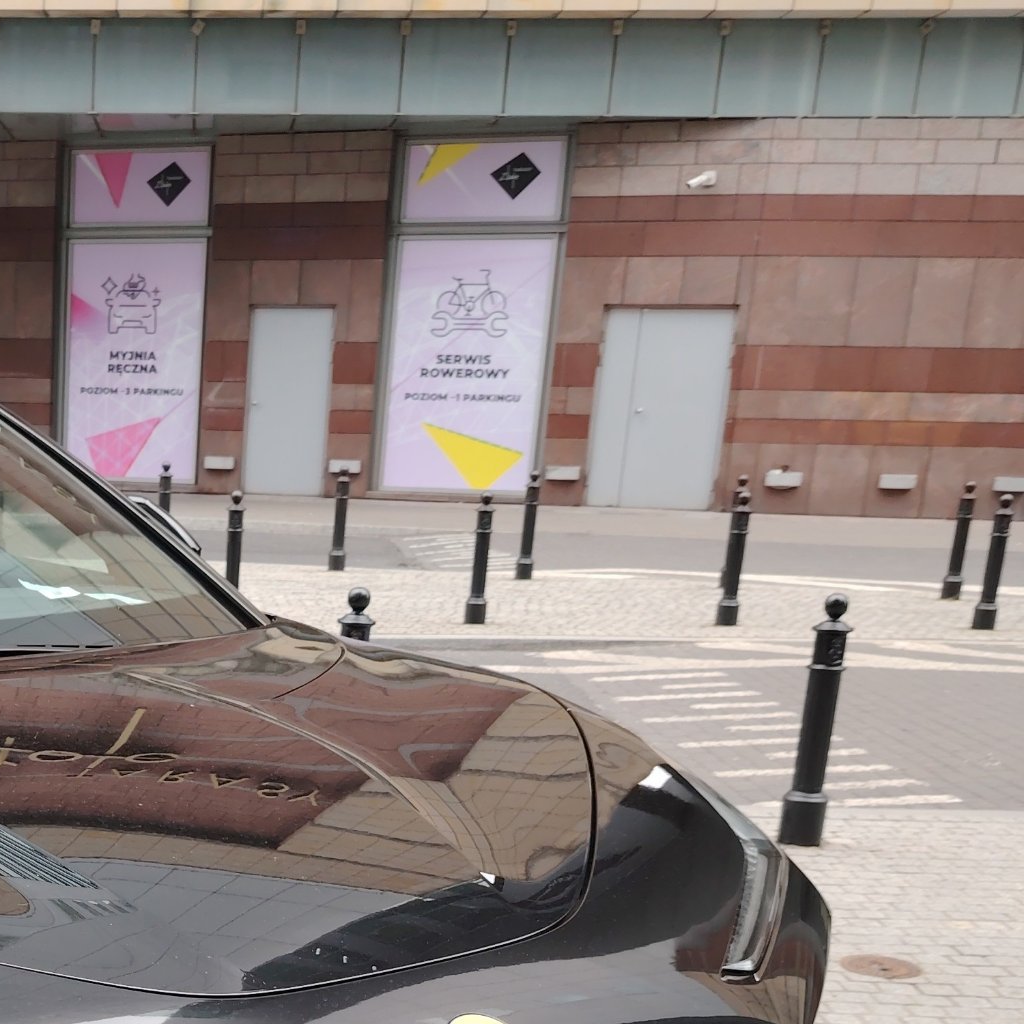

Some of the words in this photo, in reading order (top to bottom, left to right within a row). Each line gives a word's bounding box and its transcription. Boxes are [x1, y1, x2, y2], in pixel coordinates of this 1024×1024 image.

[109, 350, 157, 361] MYJNIA
[436, 354, 492, 365] SERWIS
[107, 363, 158, 376] RĘCZNA
[419, 367, 510, 379] ROWEROWY
[79, 386, 118, 395] POZIOM
[133, 387, 184, 397] PARKINGU
[404, 392, 448, 401] POZIOM
[462, 393, 522, 403] PARKINGU
